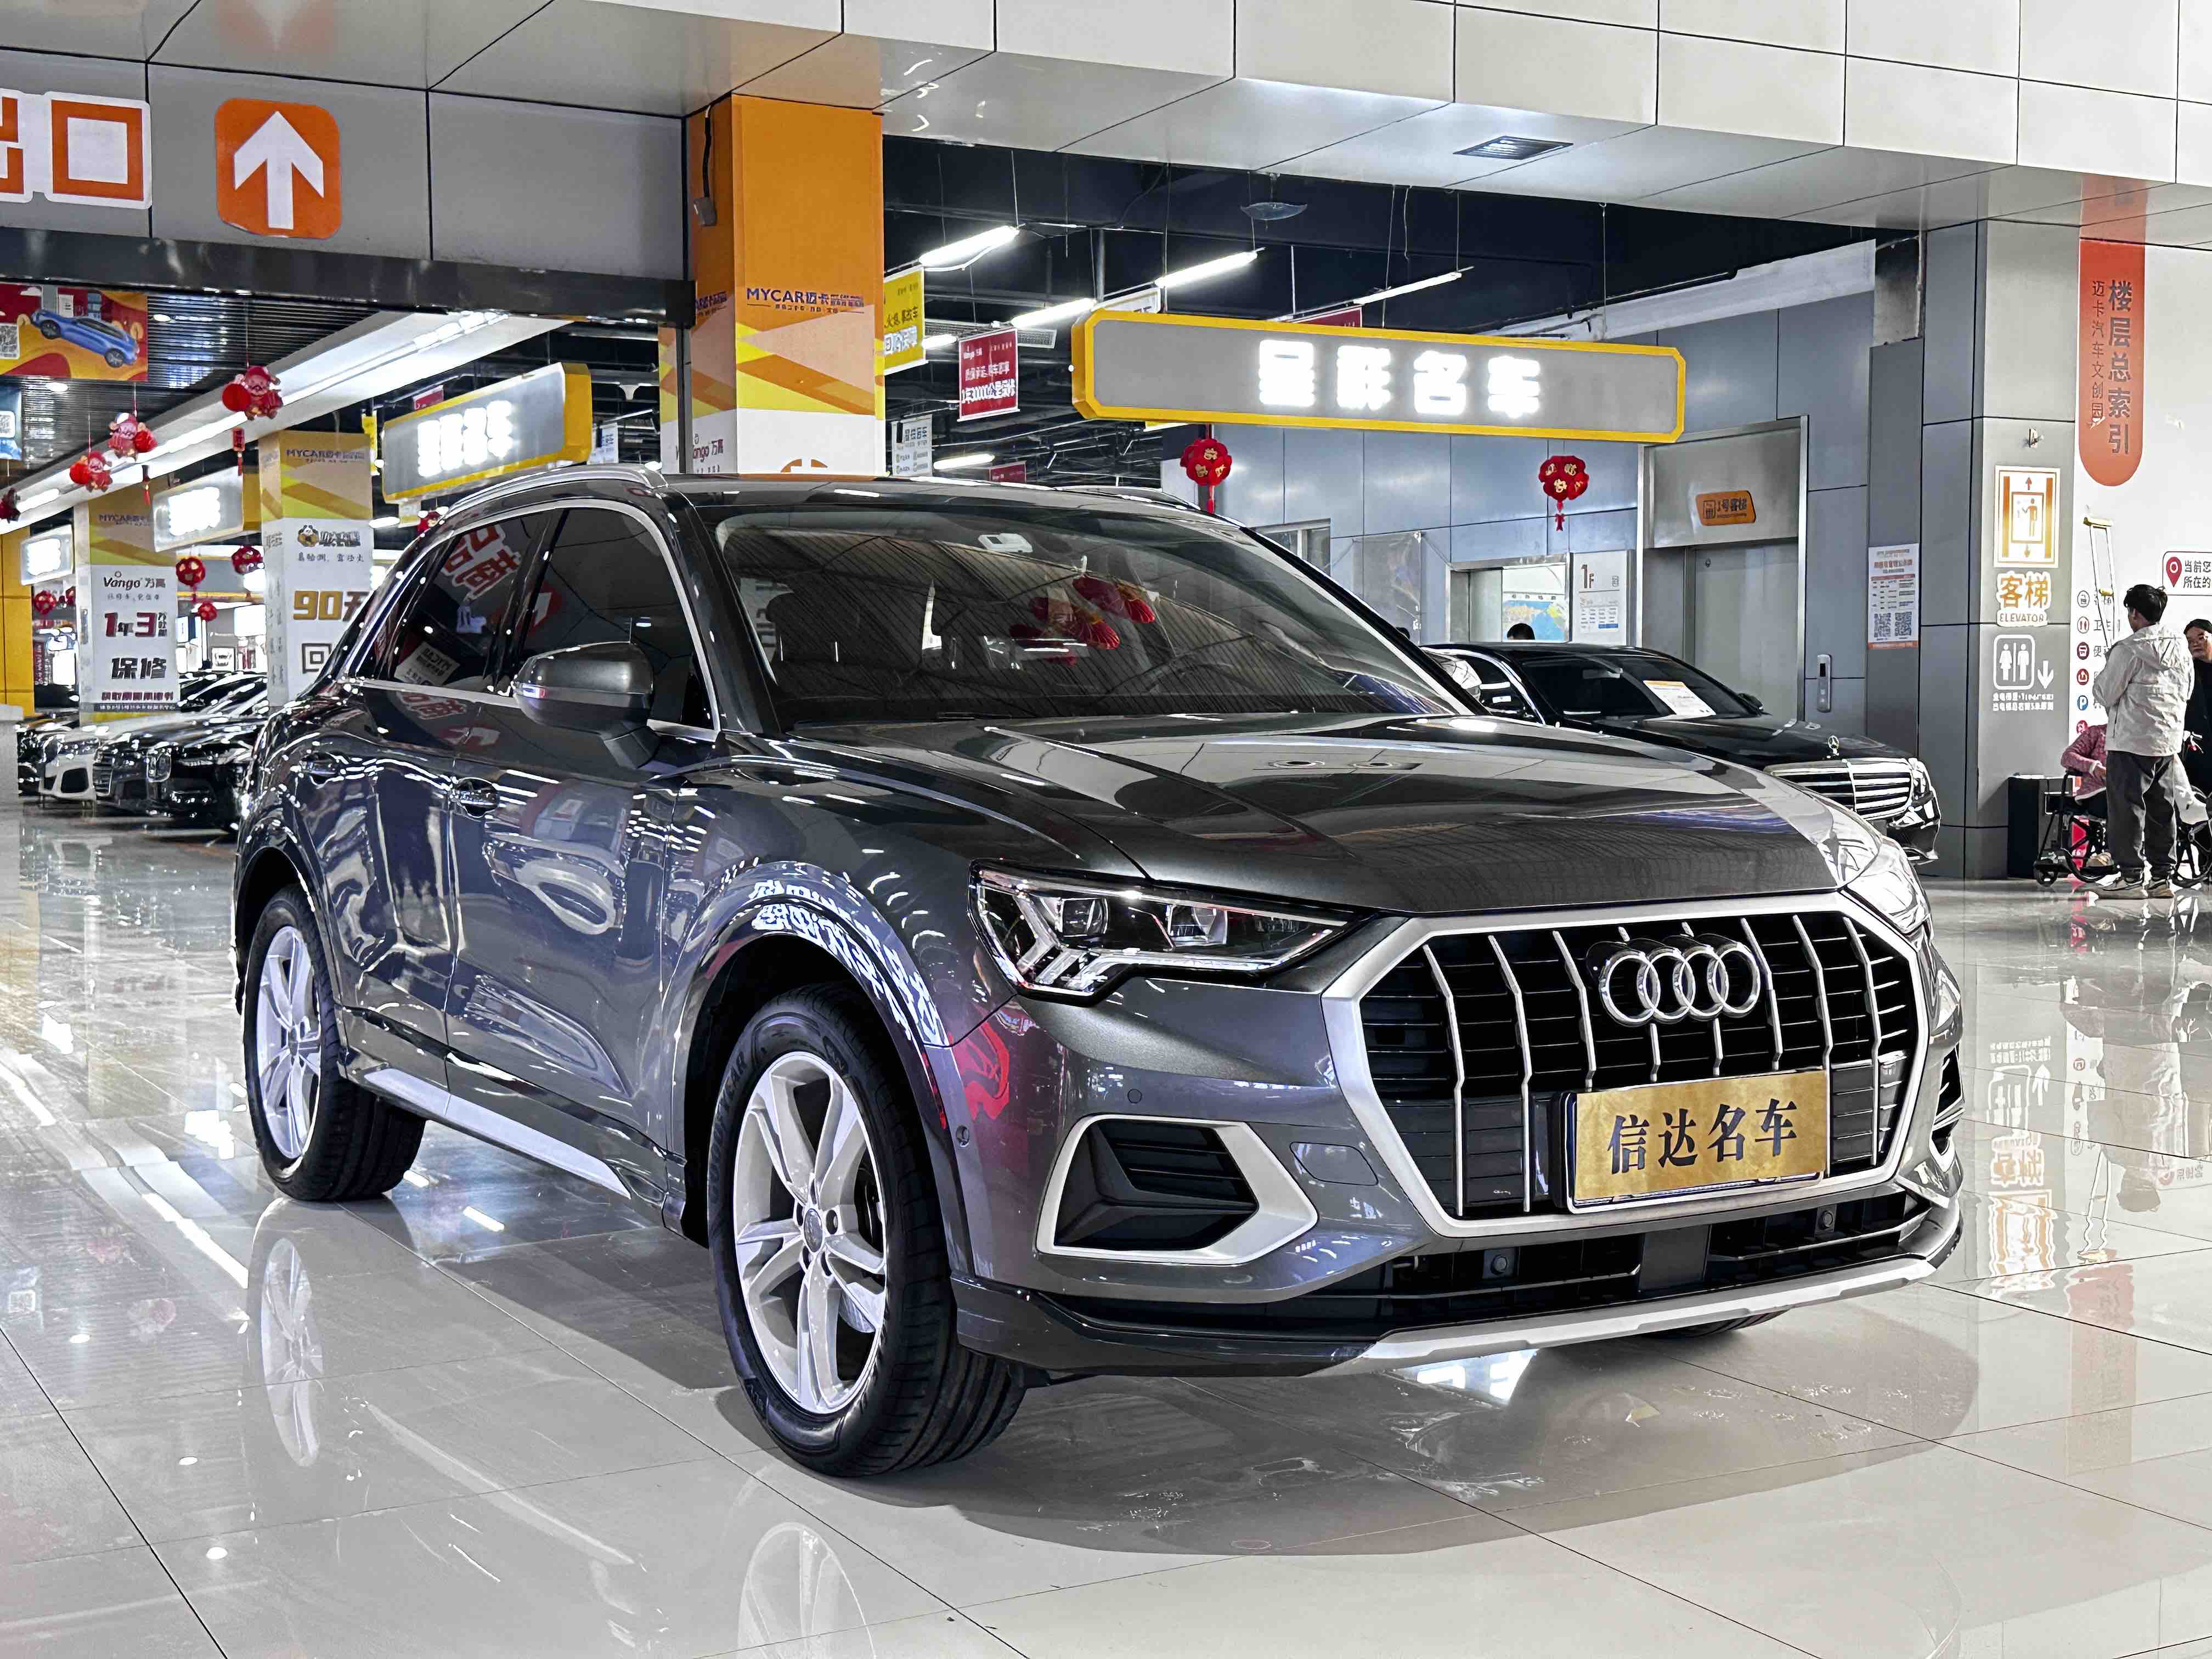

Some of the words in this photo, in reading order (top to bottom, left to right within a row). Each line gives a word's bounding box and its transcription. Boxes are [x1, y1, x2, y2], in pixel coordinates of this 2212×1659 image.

[2091, 280, 2105, 420] 迈卡汽车文创园
[2108, 279, 2132, 454] 楼层总索引
[1581, 564, 1595, 589] 1F
[2183, 576, 2211, 589] 所在的
[2000, 575, 2049, 608] 客梯
[2000, 613, 2044, 623] ELEVATOR
[111, 657, 166, 680] 保修
[1607, 1098, 1797, 1174] 信达名车
